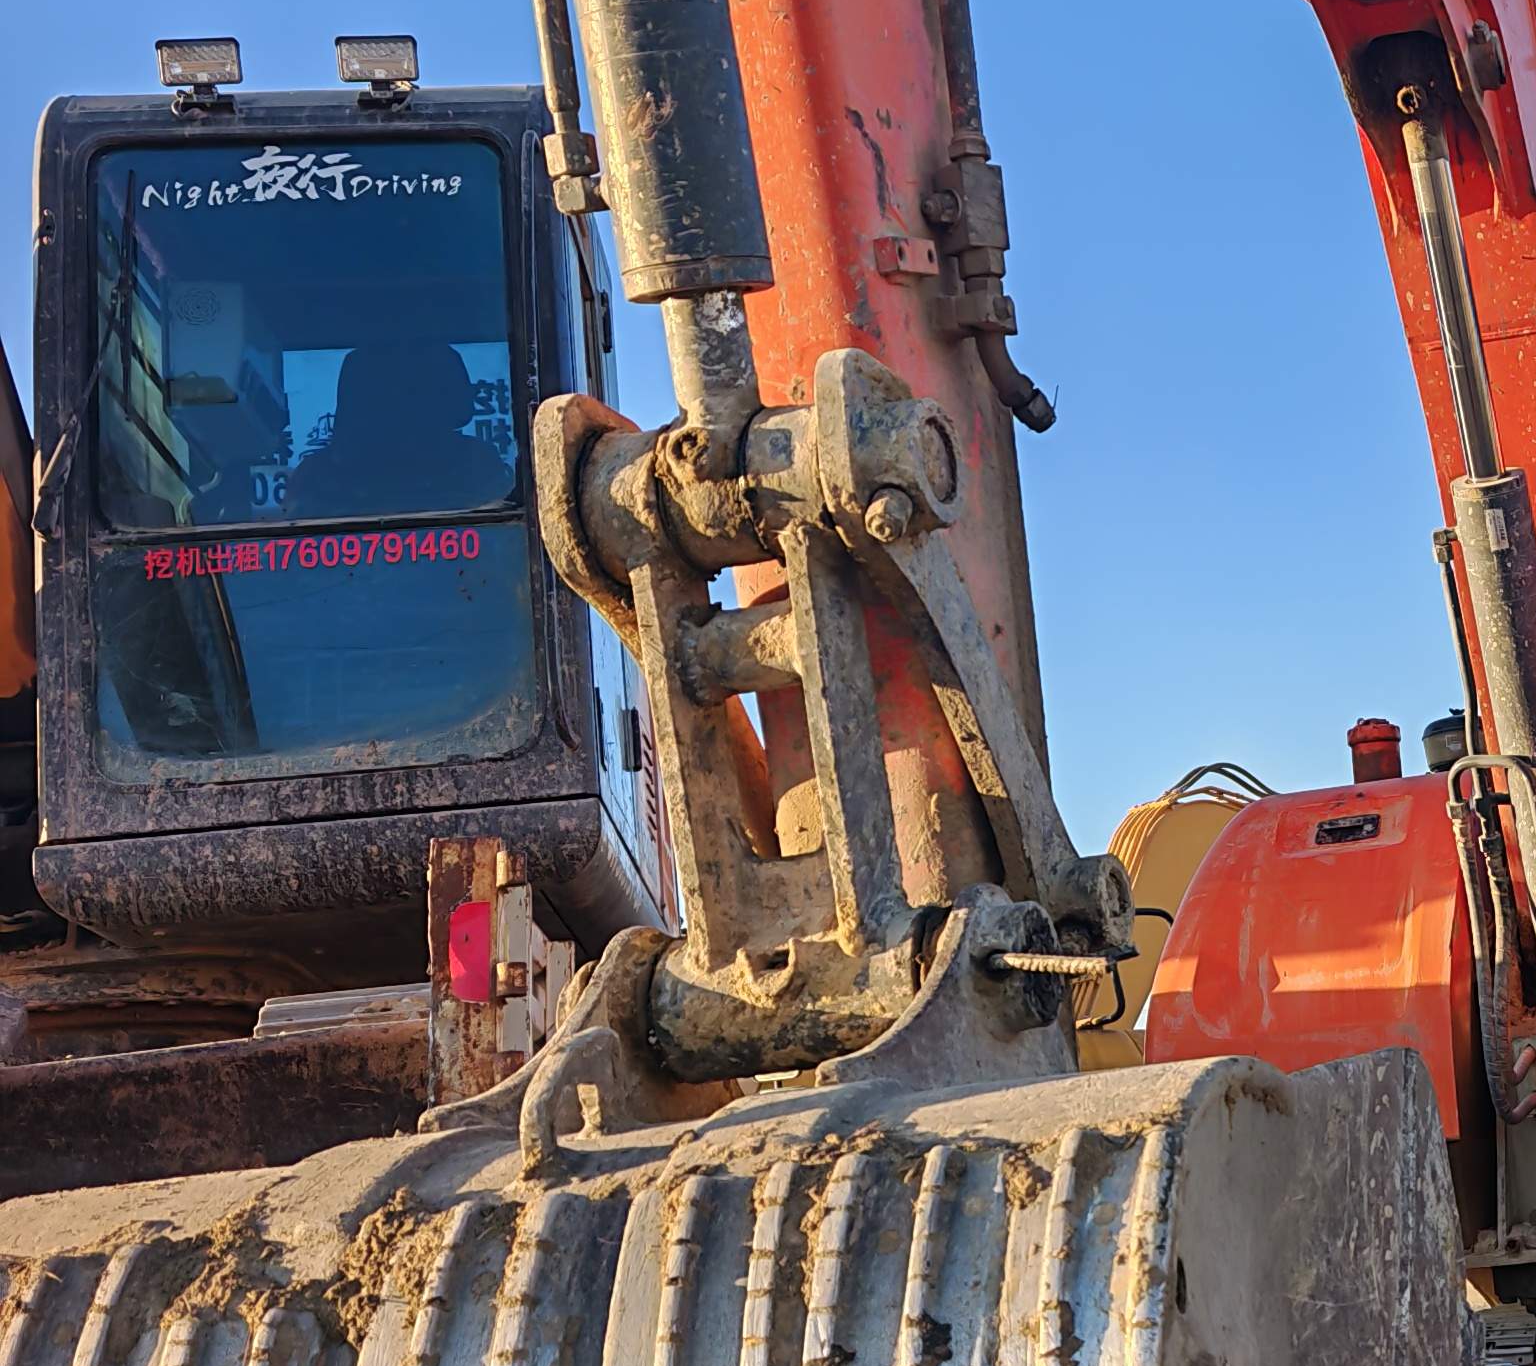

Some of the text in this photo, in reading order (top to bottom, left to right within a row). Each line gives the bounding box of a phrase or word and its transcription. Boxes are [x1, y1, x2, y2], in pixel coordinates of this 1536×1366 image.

[142, 146, 462, 209] Night 夜行 Driving
[143, 529, 480, 581] 挖机出租17609791460
